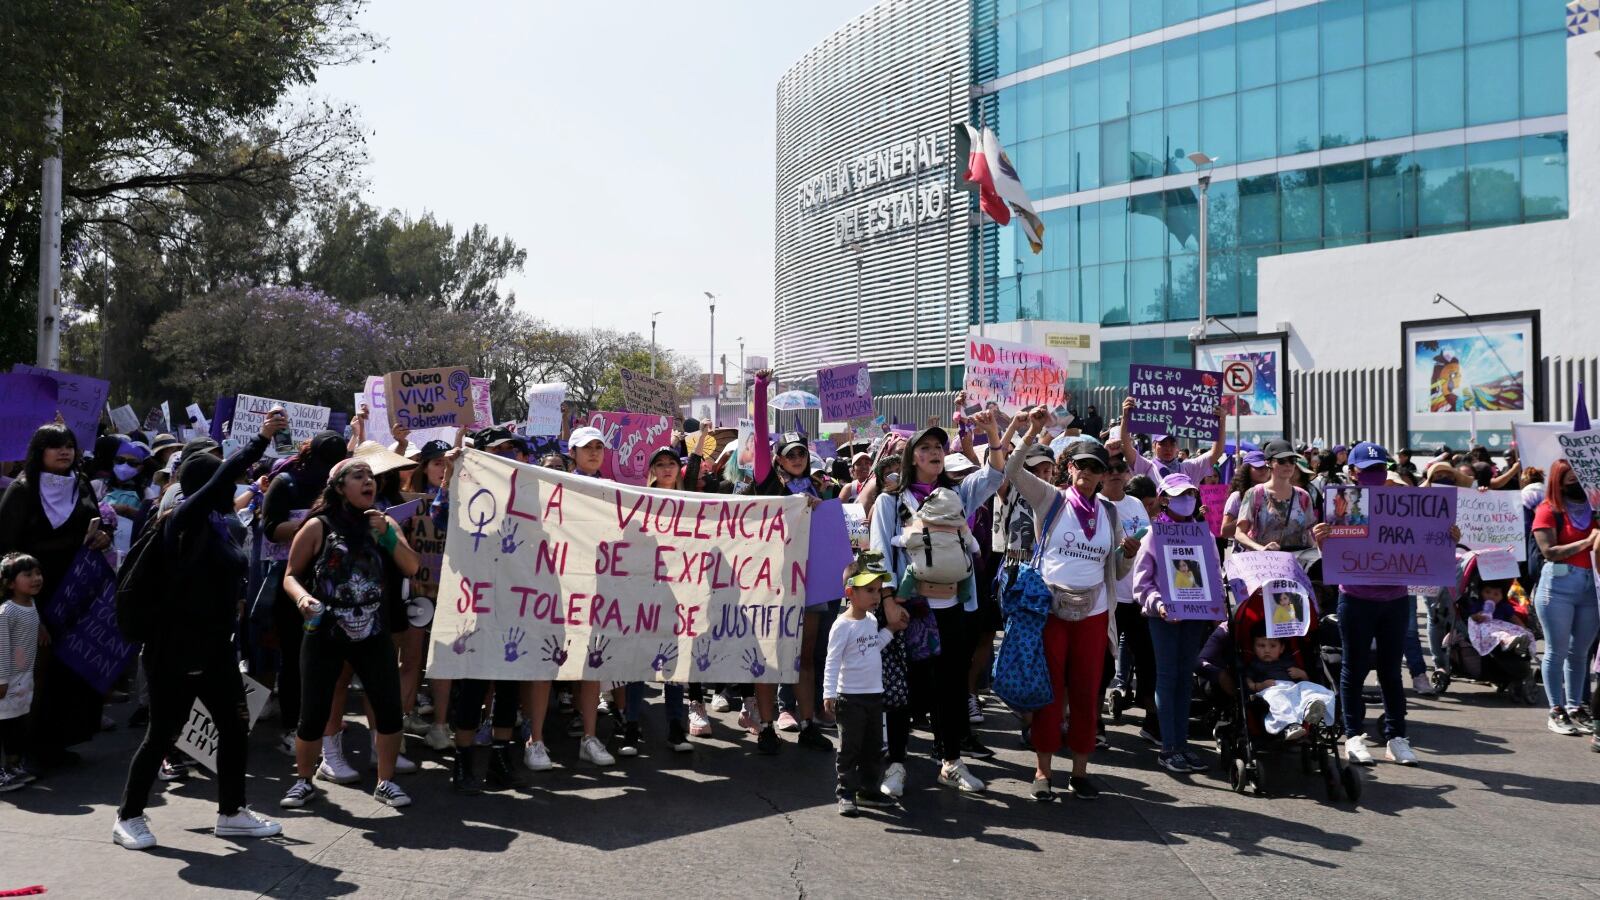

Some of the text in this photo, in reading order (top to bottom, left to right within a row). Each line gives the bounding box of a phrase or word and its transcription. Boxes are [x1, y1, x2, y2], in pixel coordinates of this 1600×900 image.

[855, 132, 944, 189] GENERAL
[835, 183, 944, 246] DEL ESTADO
[971, 341, 996, 363] NO
[401, 372, 442, 387] Quiero
[398, 385, 447, 405] VIVIR
[1133, 382, 1218, 397] PARA QUE MIS
[238, 395, 248, 409] MI
[417, 402, 435, 414] no
[1182, 402, 1215, 415] VIVA
[397, 408, 457, 428] Sobrevivir
[1131, 413, 1219, 429] LIBRES Y SIN
[1166, 424, 1212, 438] MIEDO
[1367, 446, 1379, 458] LA
[1565, 447, 1587, 458] QUE
[506, 468, 792, 545] LA VIOLENCIA,
[1374, 493, 1450, 518] JUSTICIA
[1491, 511, 1519, 522] NIÑA
[1156, 522, 1204, 536] JUSTICIA
[1329, 527, 1365, 535] JUSTICIA
[1378, 525, 1415, 545] PARA
[416, 539, 445, 554] QUIE
[1075, 542, 1106, 555] Abuela
[1172, 547, 1194, 555] #8M
[535, 539, 569, 577] NI
[595, 540, 631, 577] SE
[1342, 550, 1428, 574] SUSANA
[1273, 580, 1298, 589] #8M
[456, 576, 493, 614] SE
[510, 586, 631, 635] TOLERA,
[635, 602, 661, 634] NI
[673, 603, 700, 637] SE
[1183, 603, 1208, 614] MAMI
